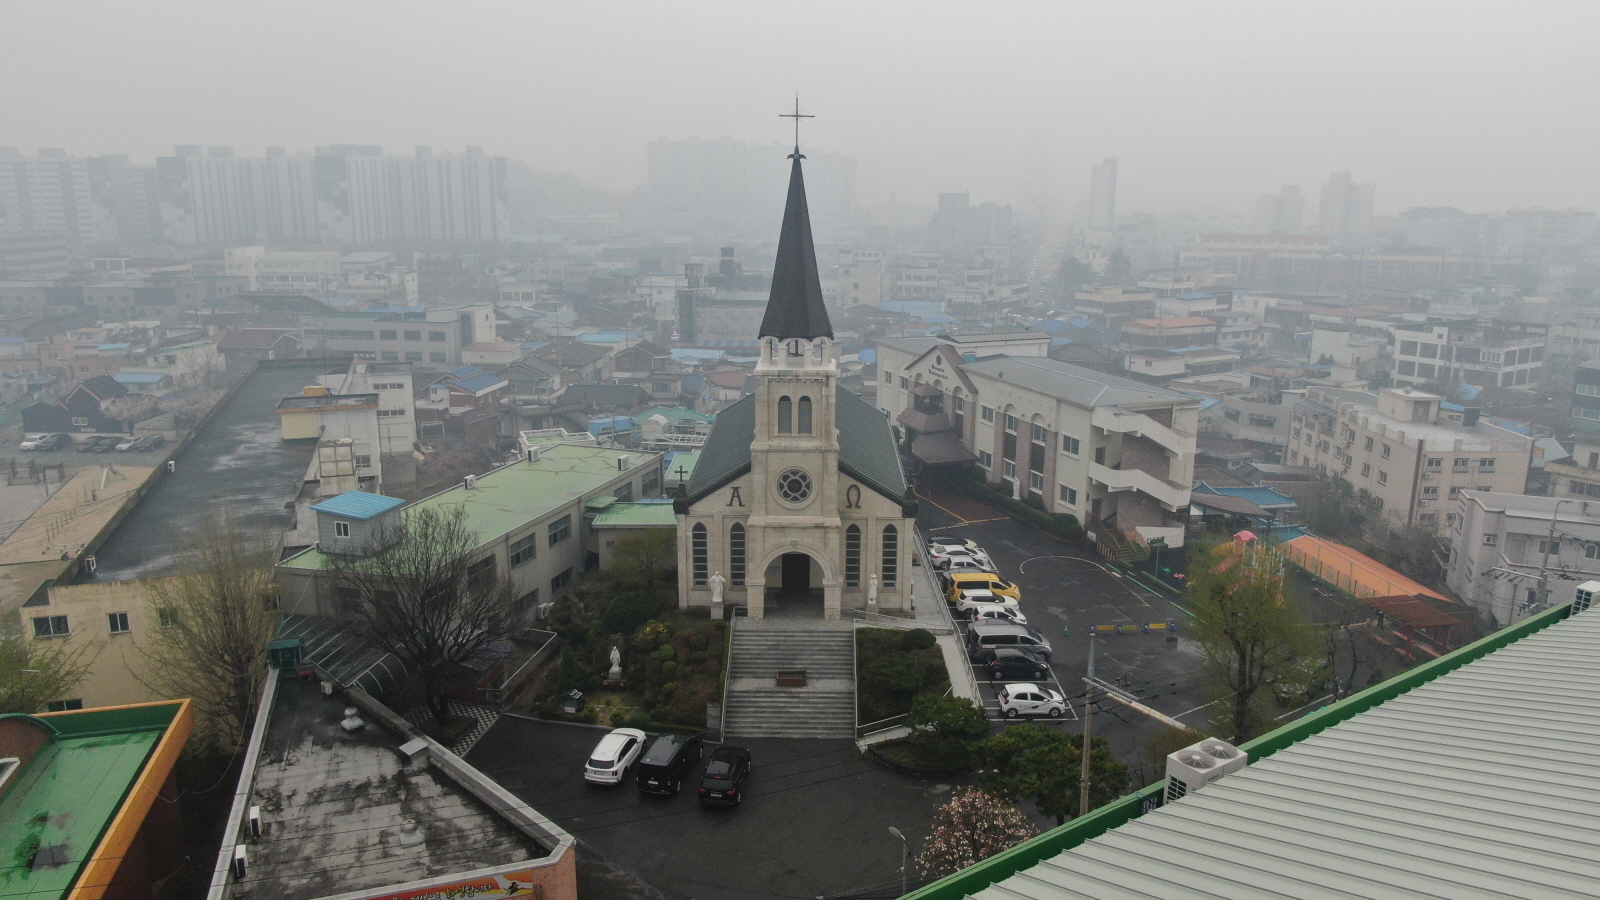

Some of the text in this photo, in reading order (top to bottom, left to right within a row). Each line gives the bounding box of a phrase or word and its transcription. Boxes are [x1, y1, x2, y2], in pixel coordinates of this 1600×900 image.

[726, 486, 746, 507] A
[846, 484, 862, 509] Ω
[445, 883, 494, 900] 환영합니다
